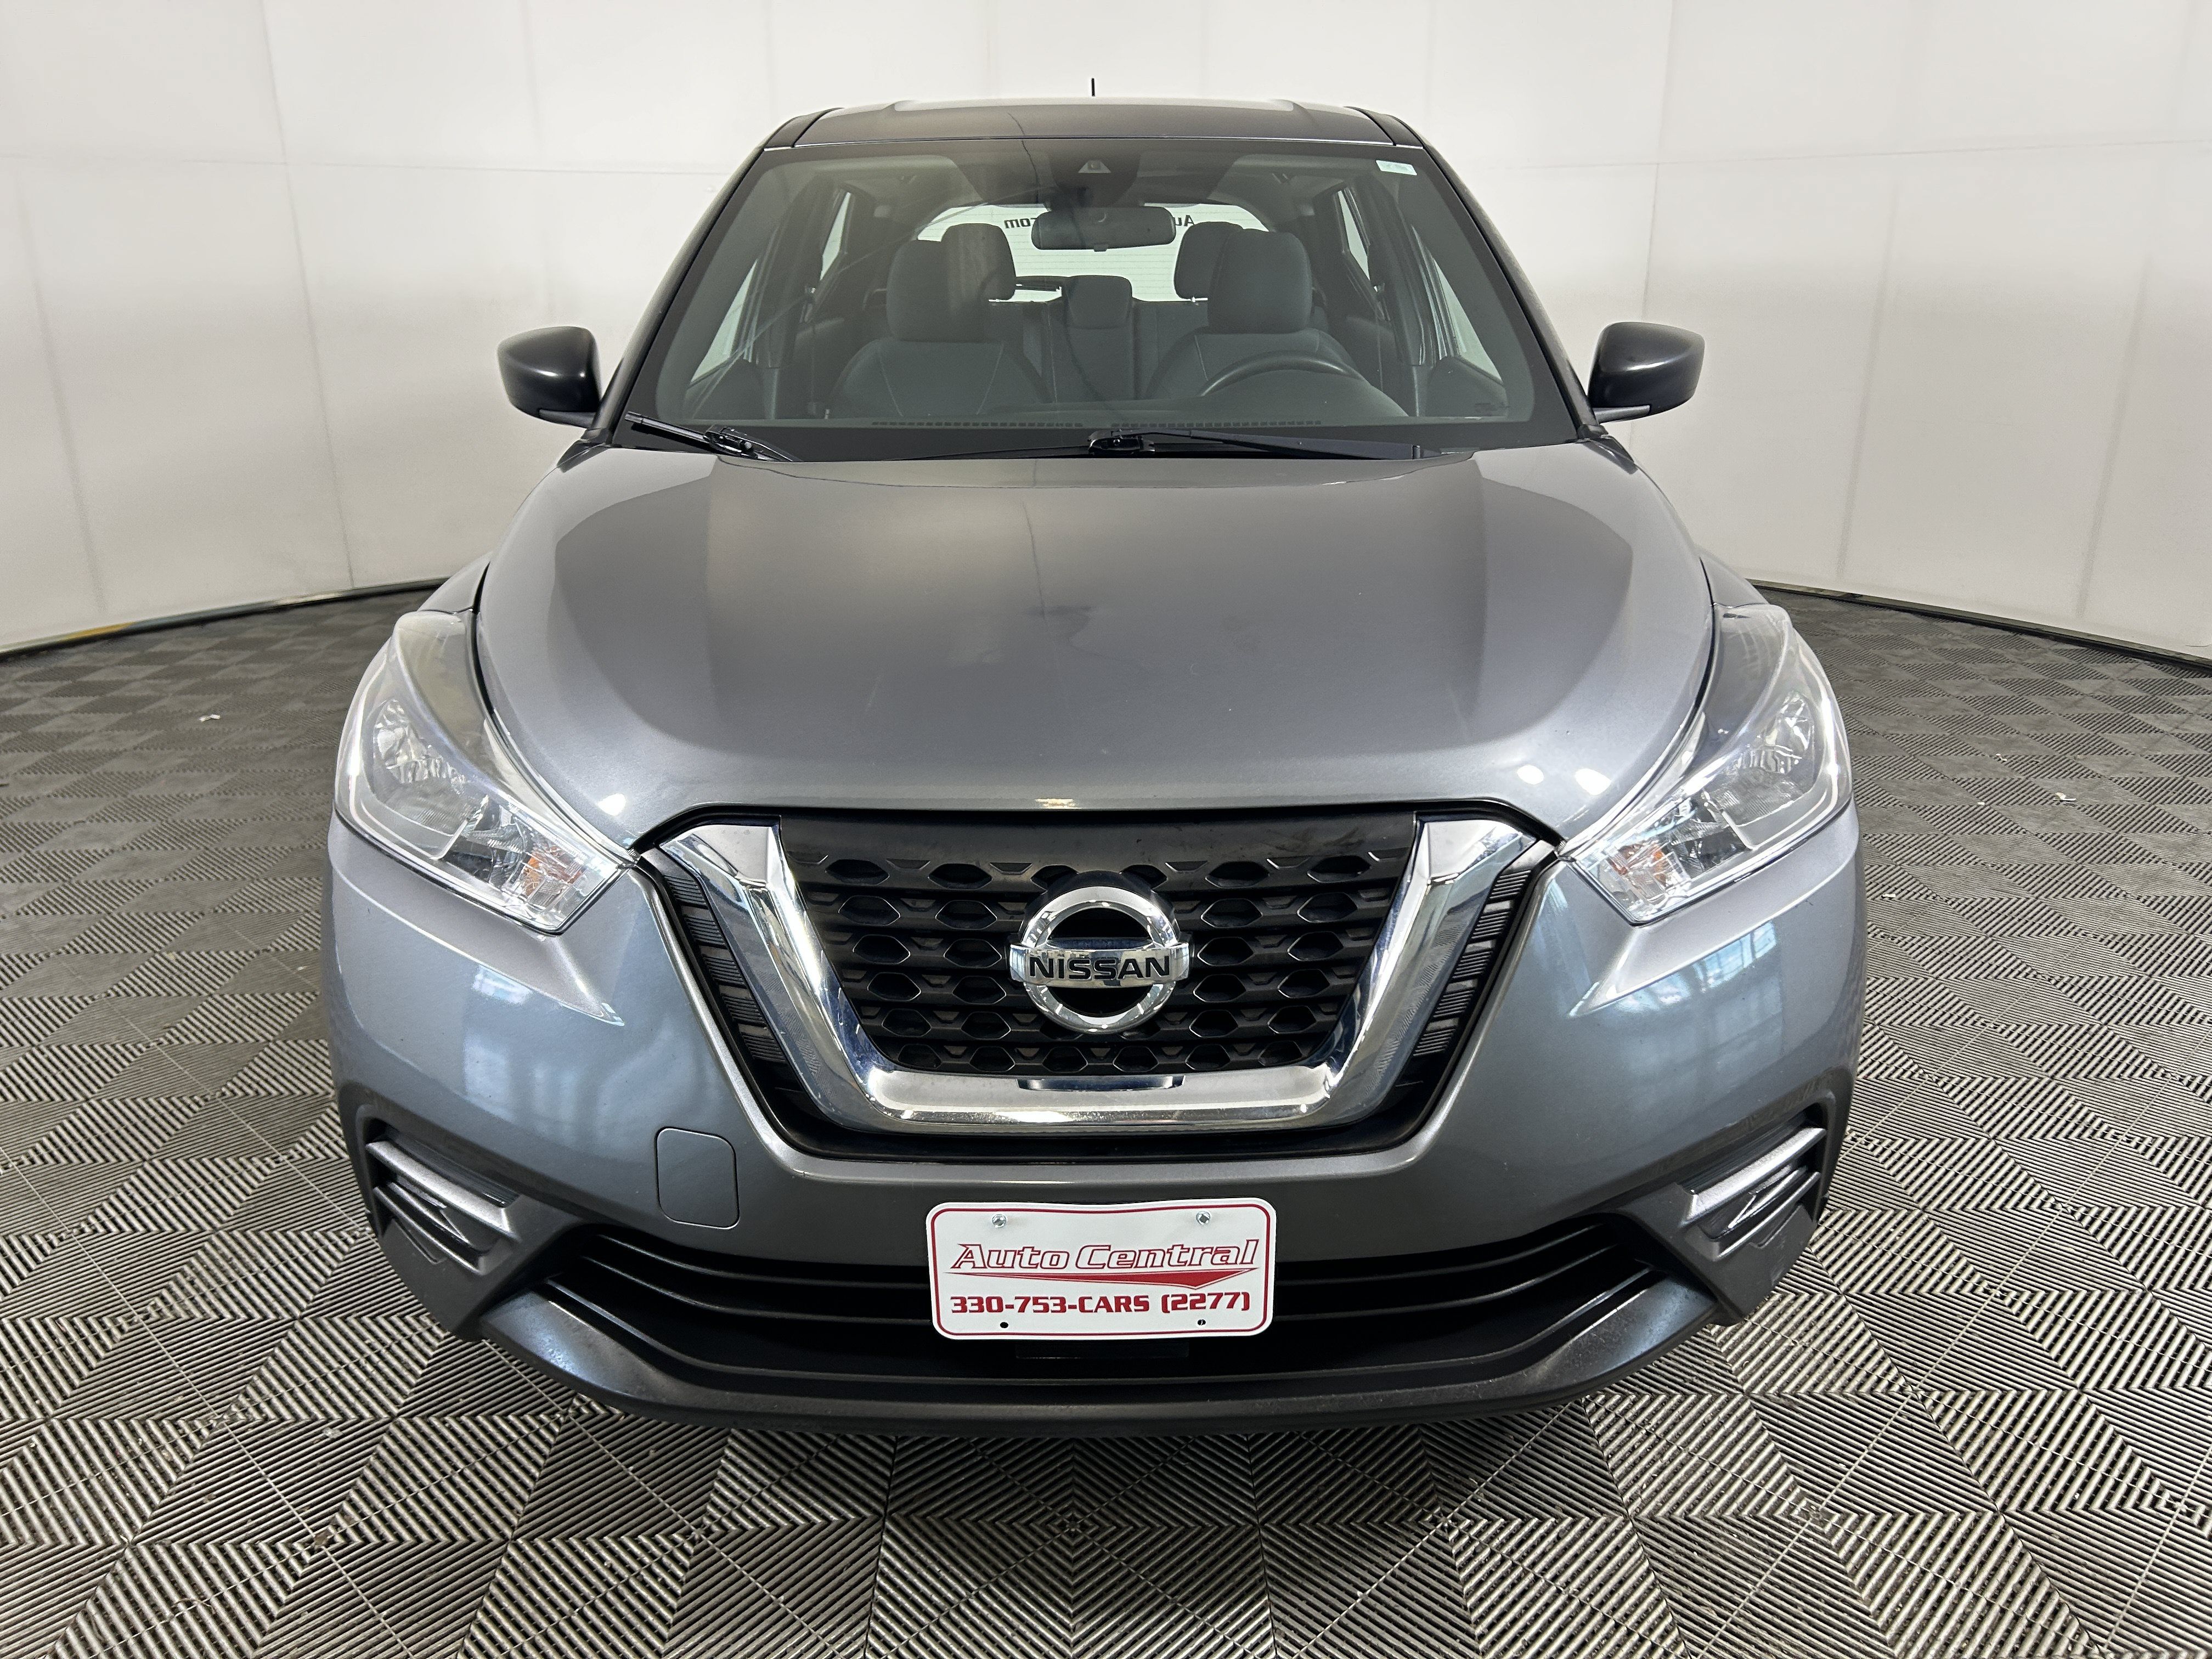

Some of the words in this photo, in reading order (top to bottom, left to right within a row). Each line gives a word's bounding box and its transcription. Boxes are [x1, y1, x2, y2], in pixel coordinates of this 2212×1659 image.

[1029, 956, 1170, 979] NISSAN
[950, 1243, 1070, 1269] Auto
[1075, 1239, 1259, 1269] Central
[950, 1295, 1150, 1313] 330-753-CARS
[1161, 1291, 1250, 1313] (2277)
